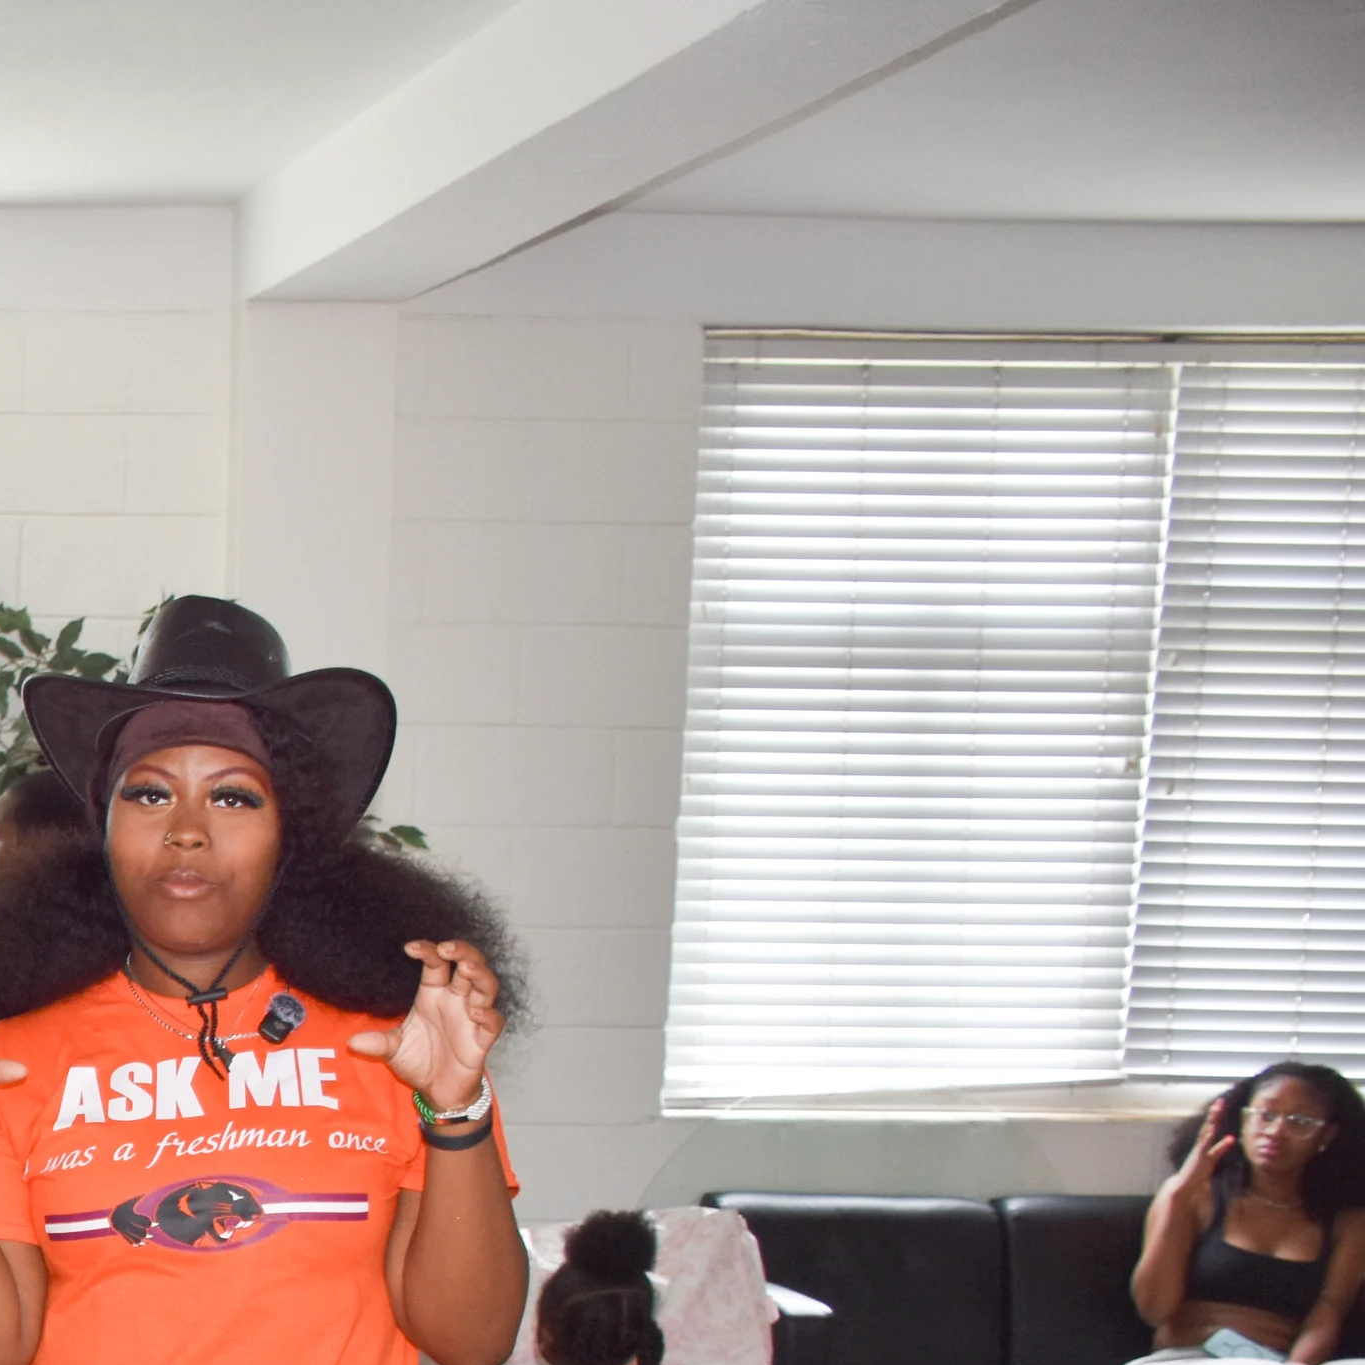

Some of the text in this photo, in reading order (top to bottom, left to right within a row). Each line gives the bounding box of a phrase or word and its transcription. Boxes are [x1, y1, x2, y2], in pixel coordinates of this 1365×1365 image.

[53, 1048, 339, 1131] ASK ME
[40, 1145, 97, 1174] was
[112, 1142, 137, 1162] a
[146, 1121, 311, 1170] freshman
[328, 1130, 389, 1156] once
